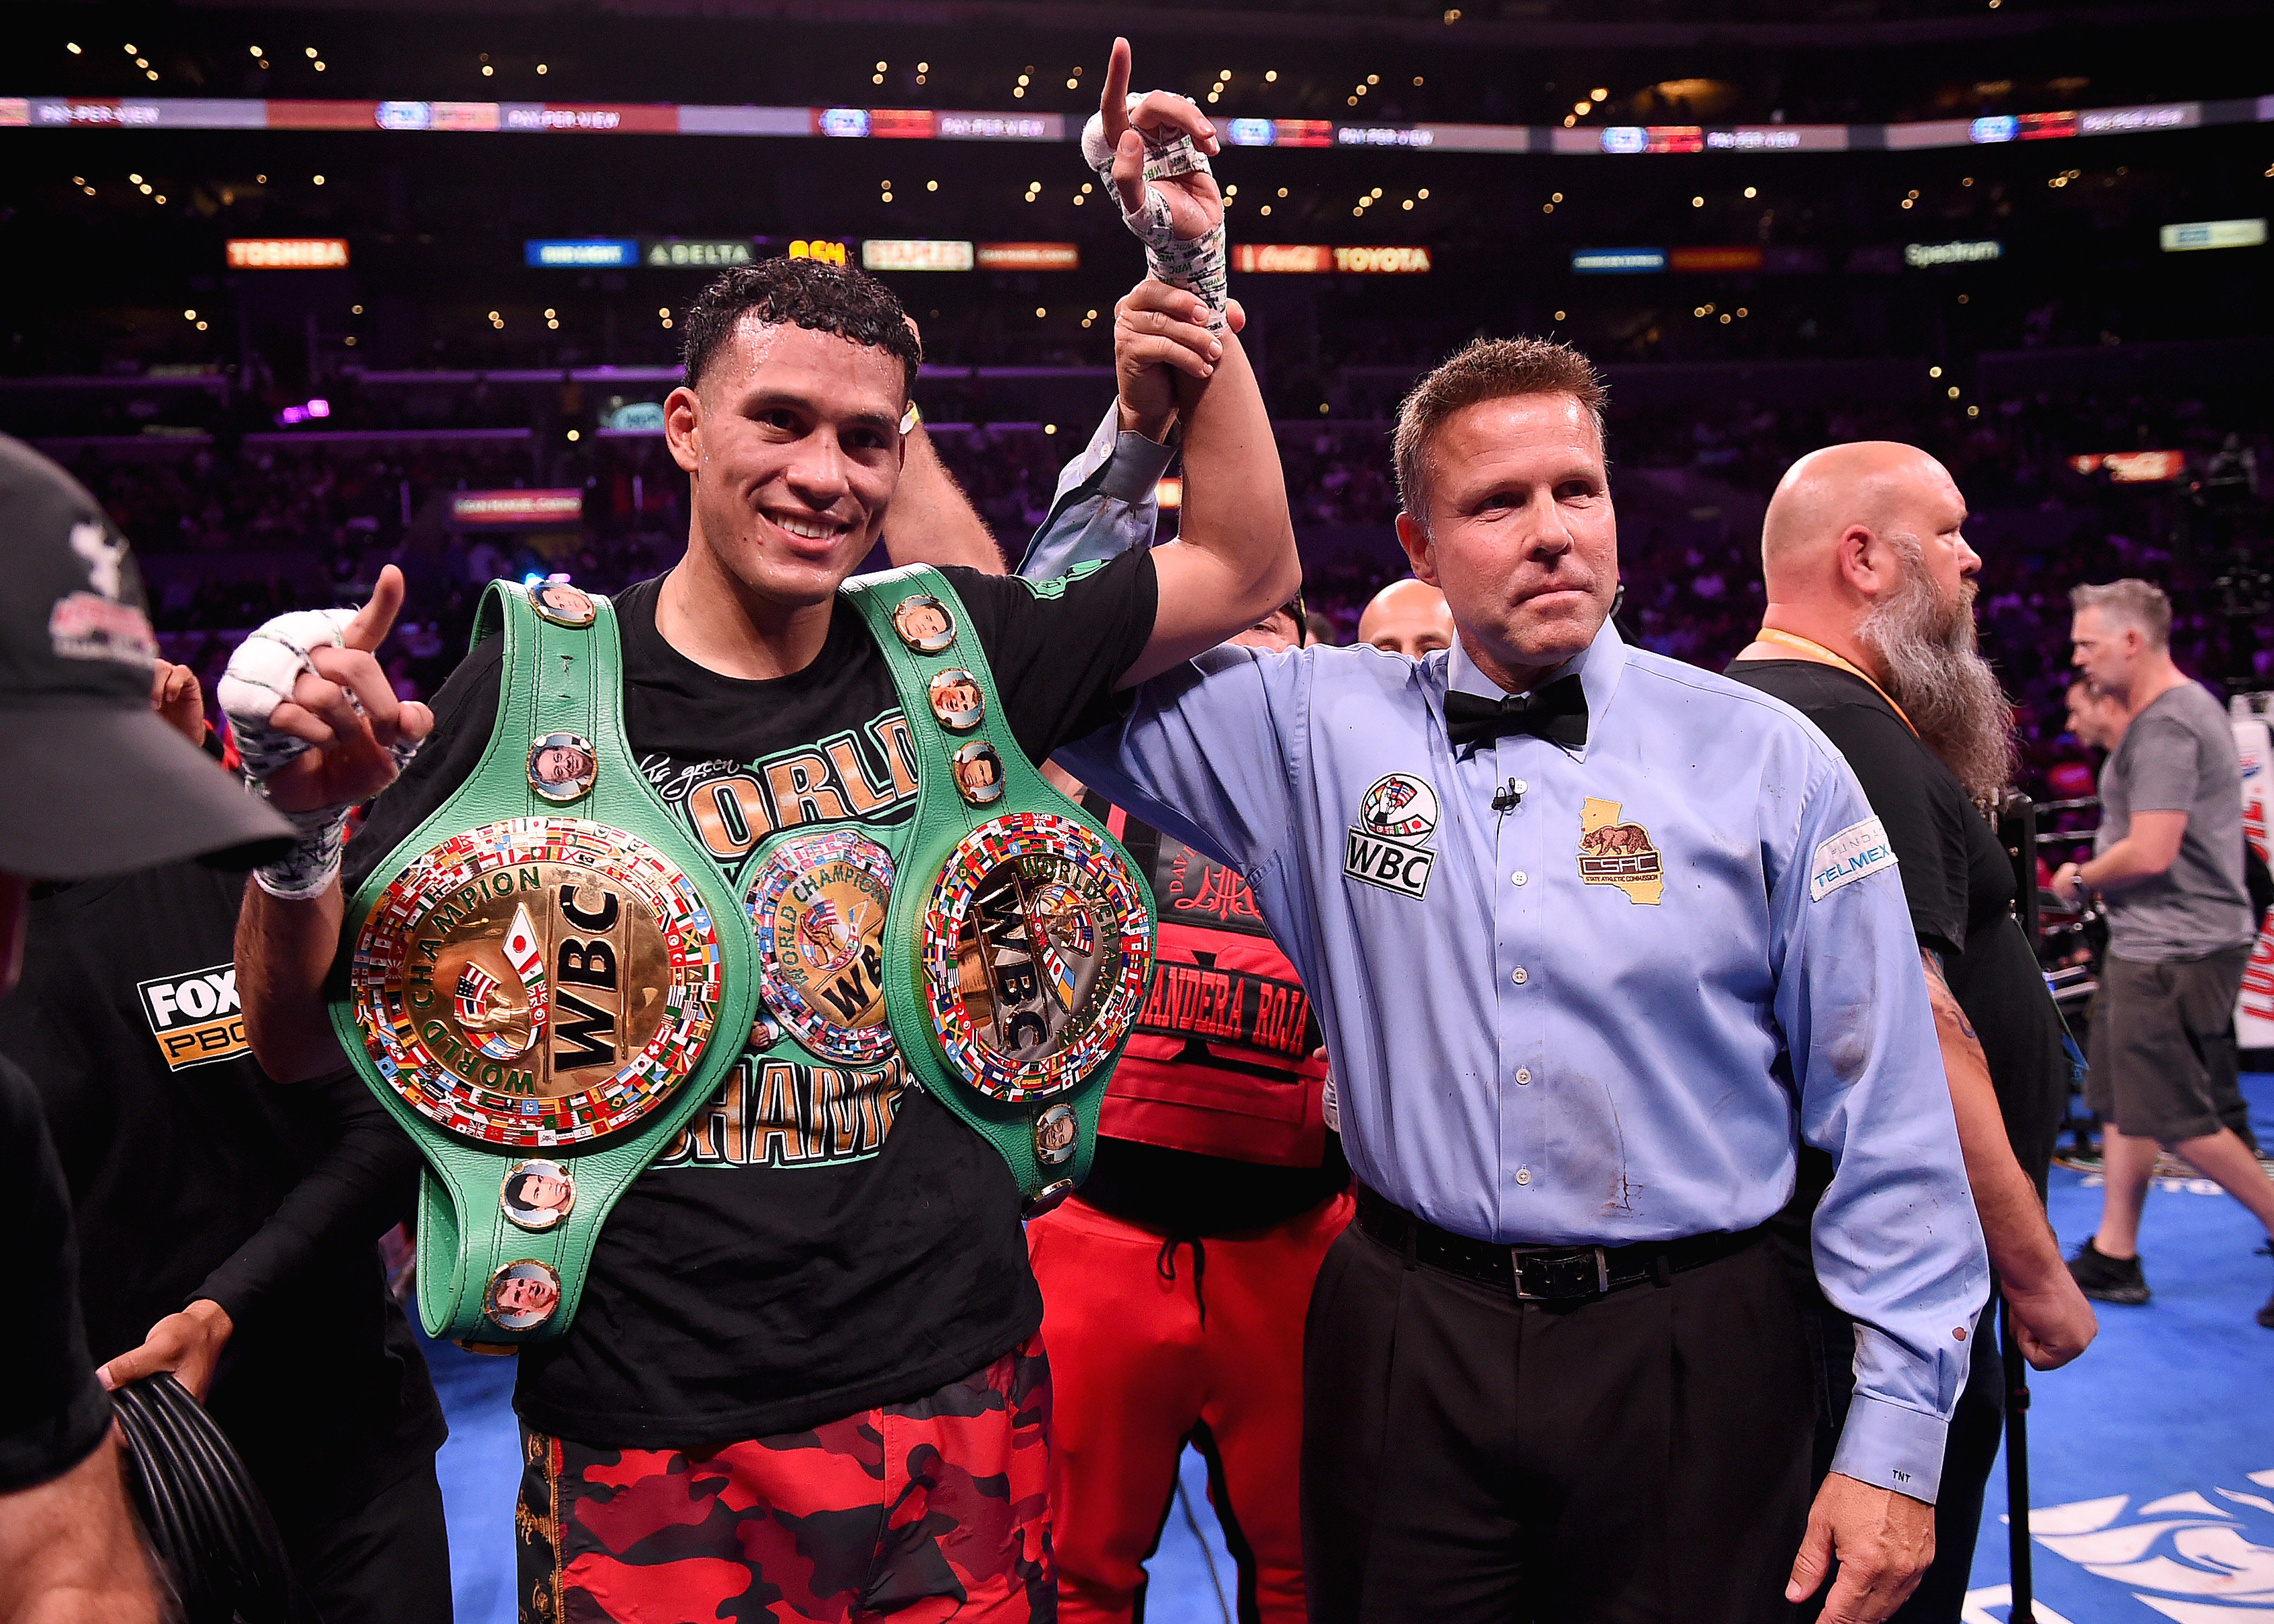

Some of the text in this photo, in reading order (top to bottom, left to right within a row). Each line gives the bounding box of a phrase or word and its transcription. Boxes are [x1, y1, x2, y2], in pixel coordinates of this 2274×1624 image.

[227, 241, 348, 266] TOSHIBA
[670, 244, 749, 266] DELTA
[1332, 246, 1431, 271] TOYOTA
[660, 759, 740, 801] green
[683, 713, 919, 858] ORLD
[1017, 855, 1102, 900] WORLD
[1169, 846, 1197, 894] DAVI
[1349, 833, 1430, 889] WBC
[1582, 855, 1657, 873] CSAC
[1814, 843, 1890, 887] TELMEX
[778, 865, 886, 988] WORLD CHAMPION
[147, 970, 242, 1027] FOX
[410, 866, 542, 1096] WORLD CHAMPION
[554, 883, 621, 1073] WBC
[820, 942, 883, 1022] WB
[1136, 965, 1310, 1055] ANDERA ROJA
[164, 1021, 247, 1058] PBC
[653, 1050, 908, 1164] HAMP
[1892, 1469, 1911, 1483] TNT
